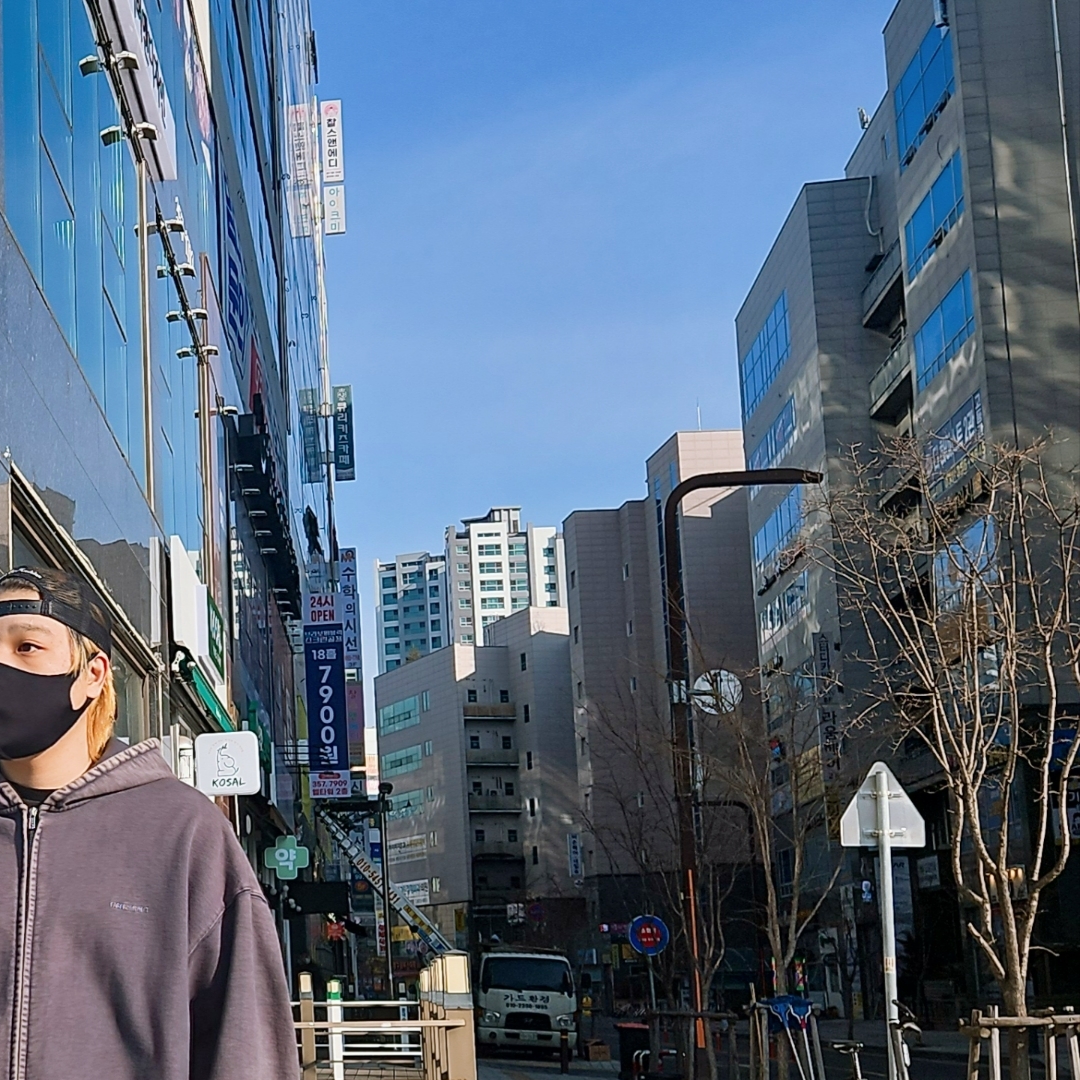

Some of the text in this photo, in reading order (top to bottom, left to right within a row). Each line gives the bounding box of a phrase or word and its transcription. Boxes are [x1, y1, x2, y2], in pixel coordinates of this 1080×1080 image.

[310, 595, 334, 607] 24시
[341, 566, 358, 652] 수학의시선
[310, 610, 335, 622] OPEN
[311, 649, 337, 660] 18홀
[318, 665, 339, 765] 7900원
[212, 777, 246, 788] KOSAL
[312, 780, 348, 788] 357.7909
[275, 848, 297, 871] 약
